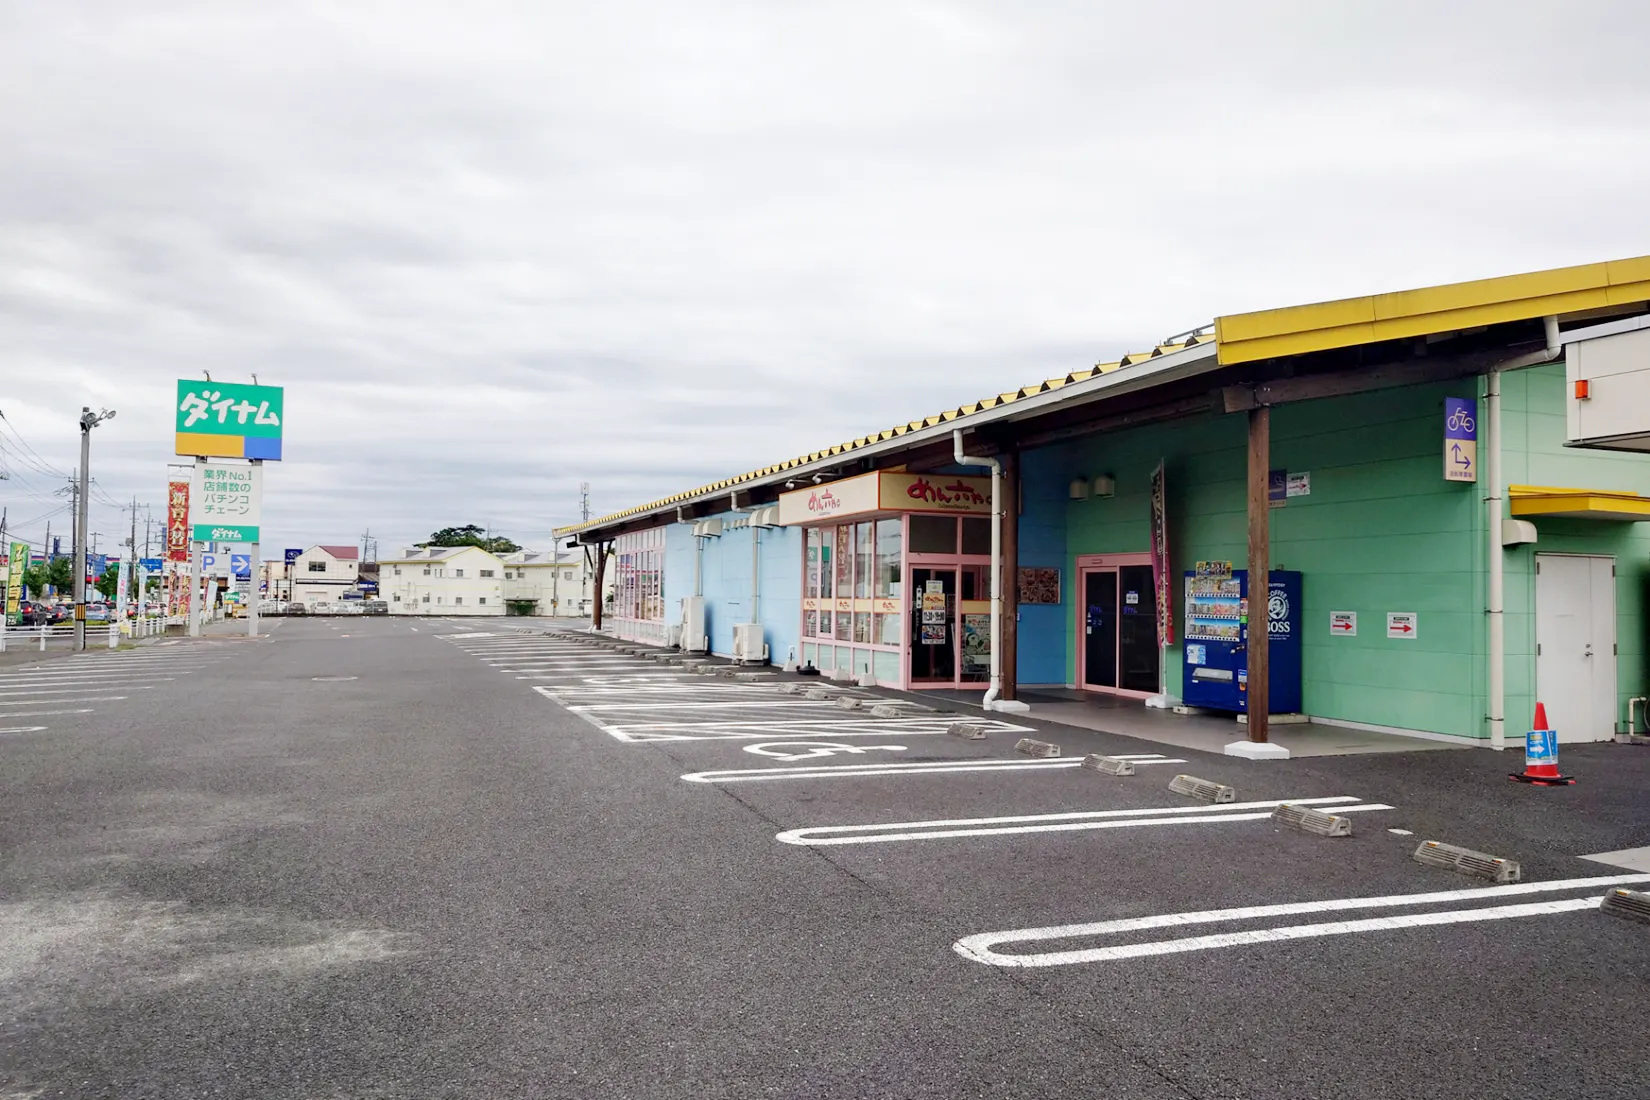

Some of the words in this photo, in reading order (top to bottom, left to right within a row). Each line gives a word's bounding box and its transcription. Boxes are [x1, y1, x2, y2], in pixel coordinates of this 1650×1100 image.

[180, 390, 280, 428] ダイナム
[203, 481, 251, 493] 店舗数の
[204, 494, 249, 505] パチンコ
[204, 504, 250, 516] チェーン
[211, 528, 243, 539] ダイナム
[203, 555, 215, 571] P
